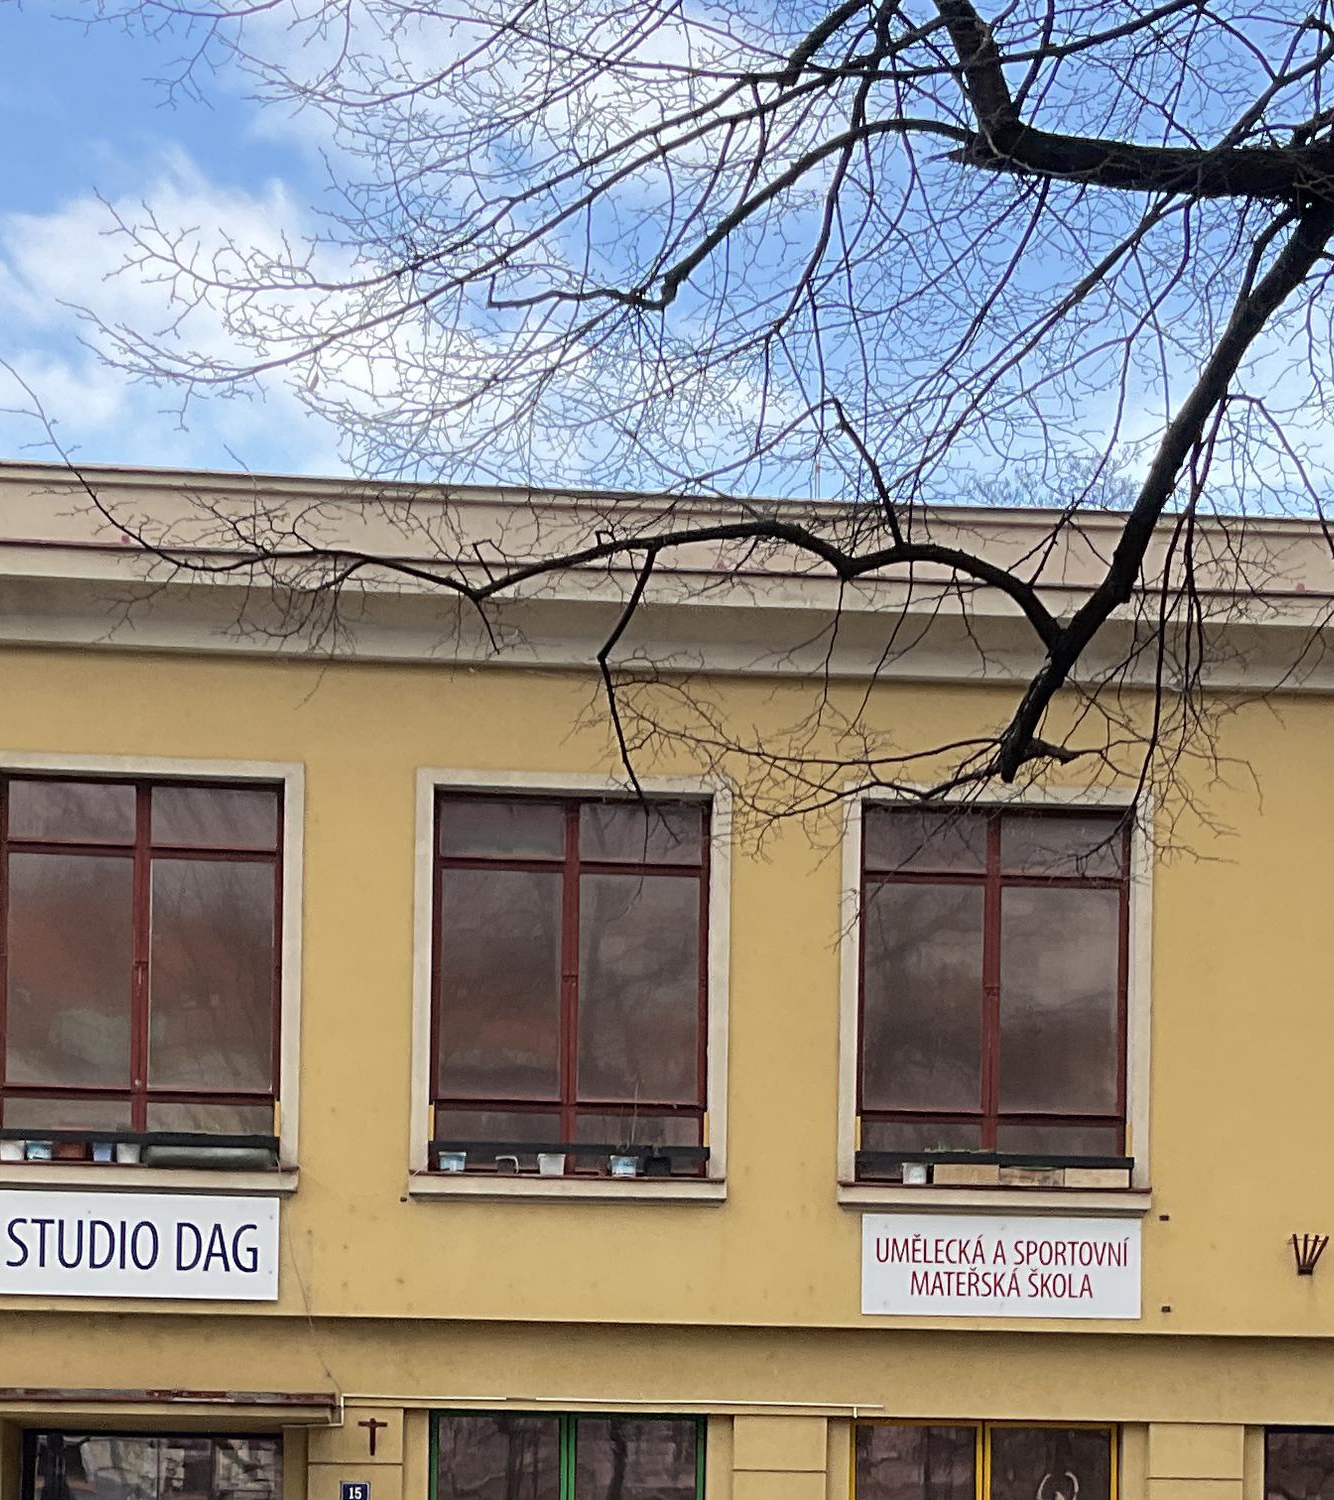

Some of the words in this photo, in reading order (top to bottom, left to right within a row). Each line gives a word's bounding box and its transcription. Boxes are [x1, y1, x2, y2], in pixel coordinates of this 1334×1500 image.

[5, 1217, 159, 1271] STUDIO
[175, 1221, 259, 1274] DAG
[875, 1233, 986, 1265] UMĚLECKÁ
[992, 1239, 1007, 1266] A
[1013, 1236, 1130, 1267] SPORTOVNÍ
[910, 1266, 1021, 1298] MATEŘSKÁ
[1027, 1267, 1094, 1299] ŠKOLA
[348, 1486, 363, 1500] 15
